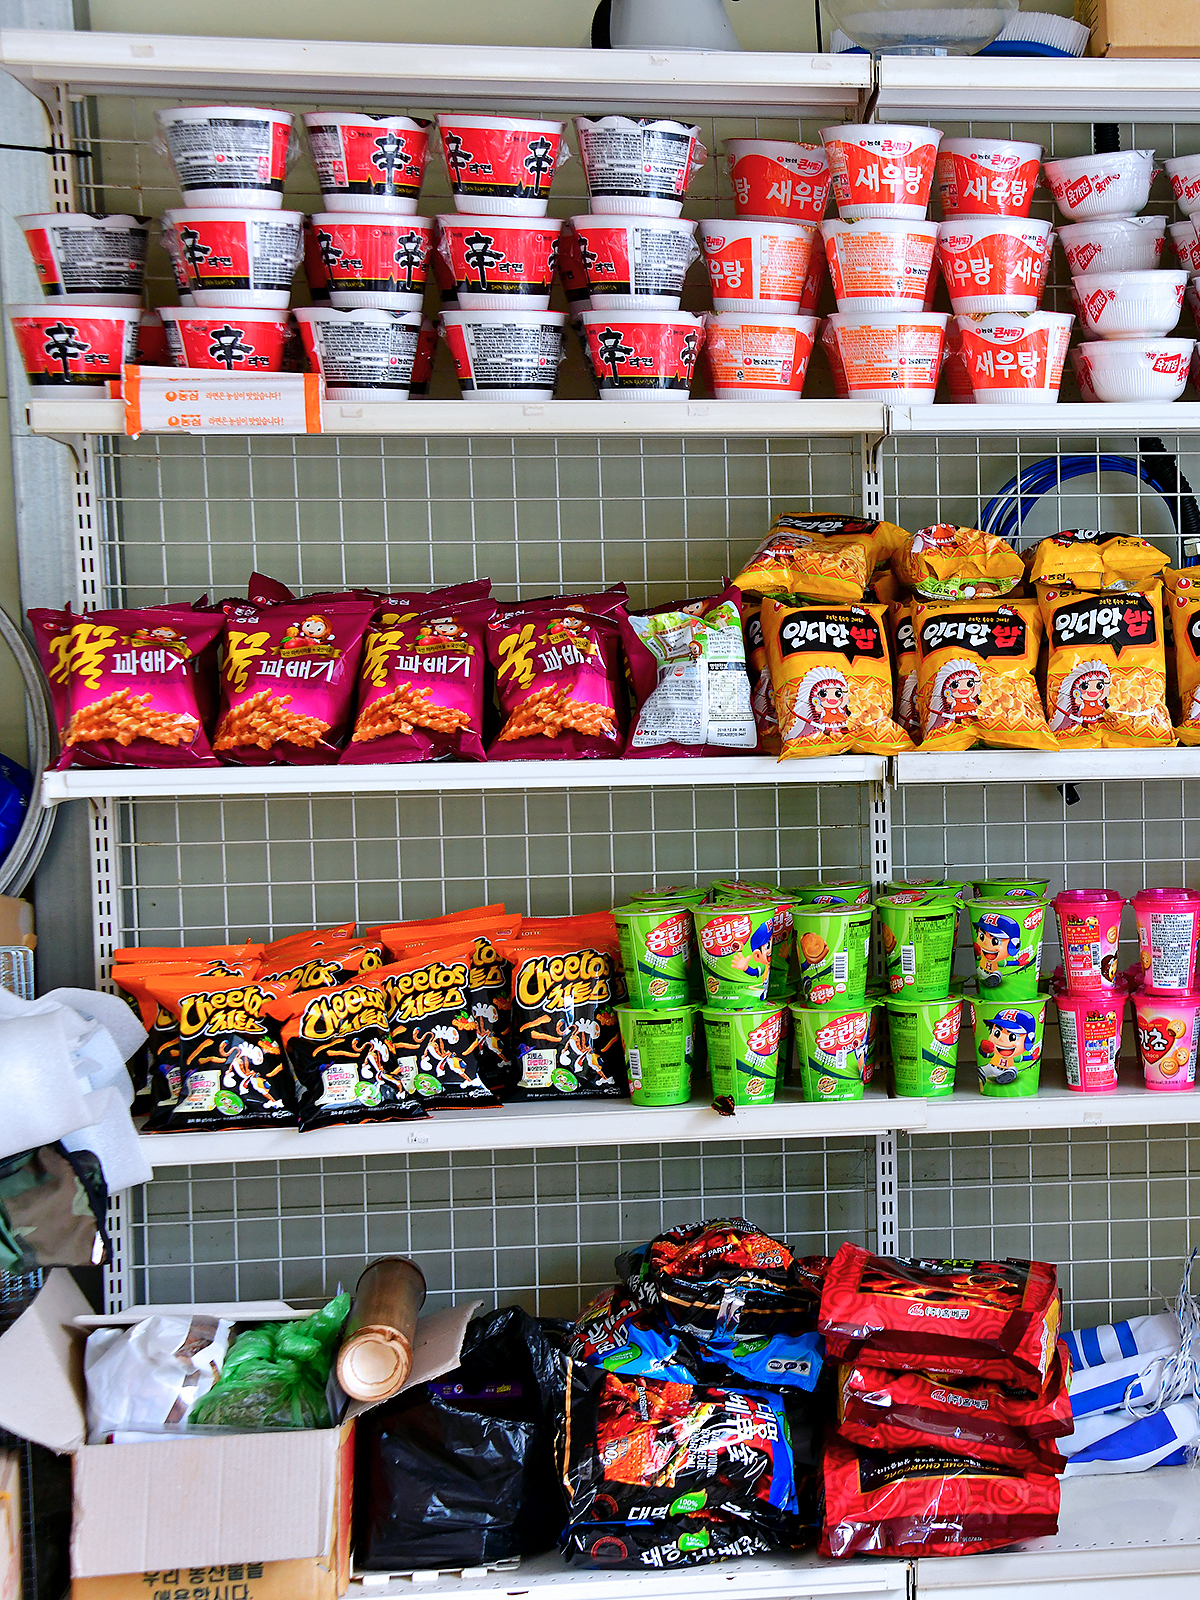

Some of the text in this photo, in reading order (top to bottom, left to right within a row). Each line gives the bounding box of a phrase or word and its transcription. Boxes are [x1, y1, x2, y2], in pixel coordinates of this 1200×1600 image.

[371, 131, 411, 196] 辛
[468, 162, 492, 175] 라면
[523, 136, 558, 197] 辛
[855, 163, 923, 195] 새우탕
[962, 177, 1028, 207] 새우탕
[1067, 177, 1092, 206] 육개장
[766, 178, 828, 212] 새우탕
[208, 255, 233, 269] 라면
[339, 259, 363, 272] 라면
[394, 231, 429, 290] 辛
[463, 231, 505, 291] 辛
[498, 261, 524, 274] 라면
[43, 321, 91, 383] 辛
[84, 354, 110, 366] 라면
[597, 327, 635, 386] 辛
[975, 350, 1041, 380] 새우탕
[1155, 356, 1181, 373] 육개장
[178, 392, 199, 401] 농심
[181, 418, 201, 426] 농심
[782, 620, 878, 650] 인디안밥
[923, 622, 1024, 649] 인디안밥
[1055, 607, 1152, 642] 인디안밥
[111, 649, 188, 677] 꽈배기
[223, 631, 336, 693] 꿀 꽈배기
[364, 630, 470, 688] 꿀 꽈배기
[701, 915, 751, 949] 홈런볼
[517, 949, 611, 1006] Cheetos
[399, 988, 466, 1021] 치토스
[546, 980, 611, 1011] 치토스
[810, 987, 836, 1002] 홈런볼
[208, 1011, 268, 1035] 치토스
[303, 985, 385, 1040] Cheetos
[816, 1012, 868, 1046] 홈런볼
[1138, 1027, 1168, 1051] 칸쵸
[679, 1499, 698, 1507] 100%
